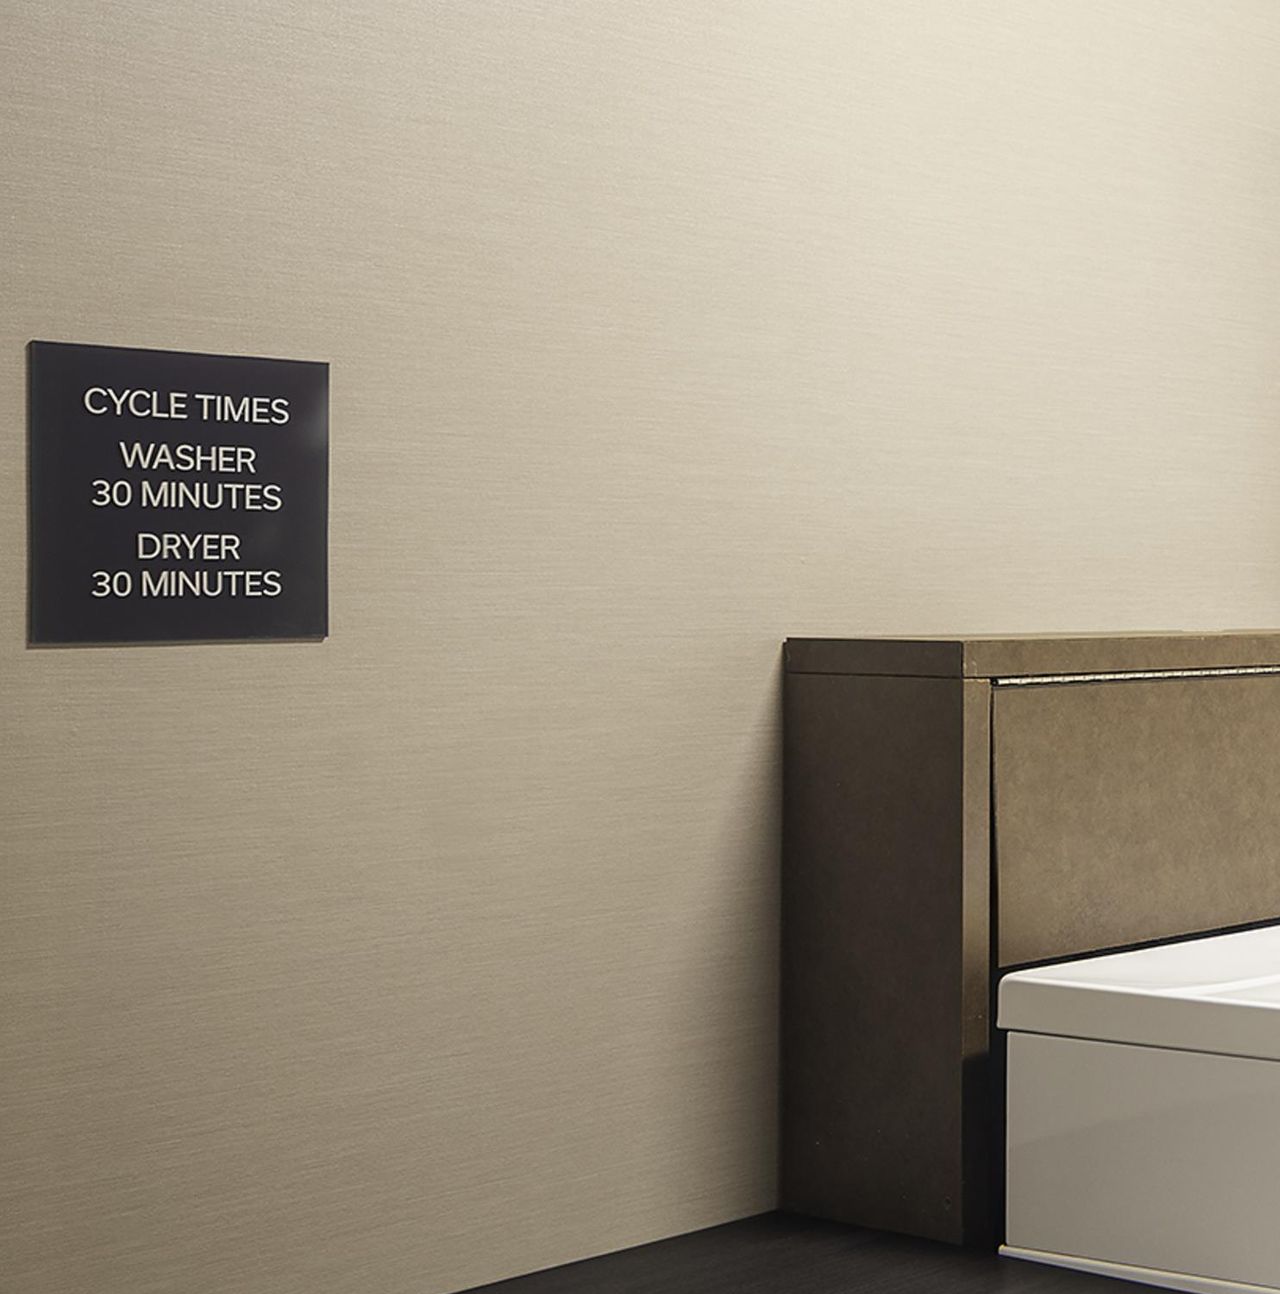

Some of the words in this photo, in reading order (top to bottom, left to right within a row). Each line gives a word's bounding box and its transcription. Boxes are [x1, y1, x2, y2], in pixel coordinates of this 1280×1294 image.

[83, 387, 189, 419] CYCLE
[194, 393, 290, 424] TIMES
[119, 441, 257, 474] WASHER
[91, 479, 133, 507] 30
[141, 480, 283, 511] MINUTES
[137, 533, 241, 560] DRYER
[91, 570, 133, 598] 30
[141, 570, 282, 598] MINUTES
